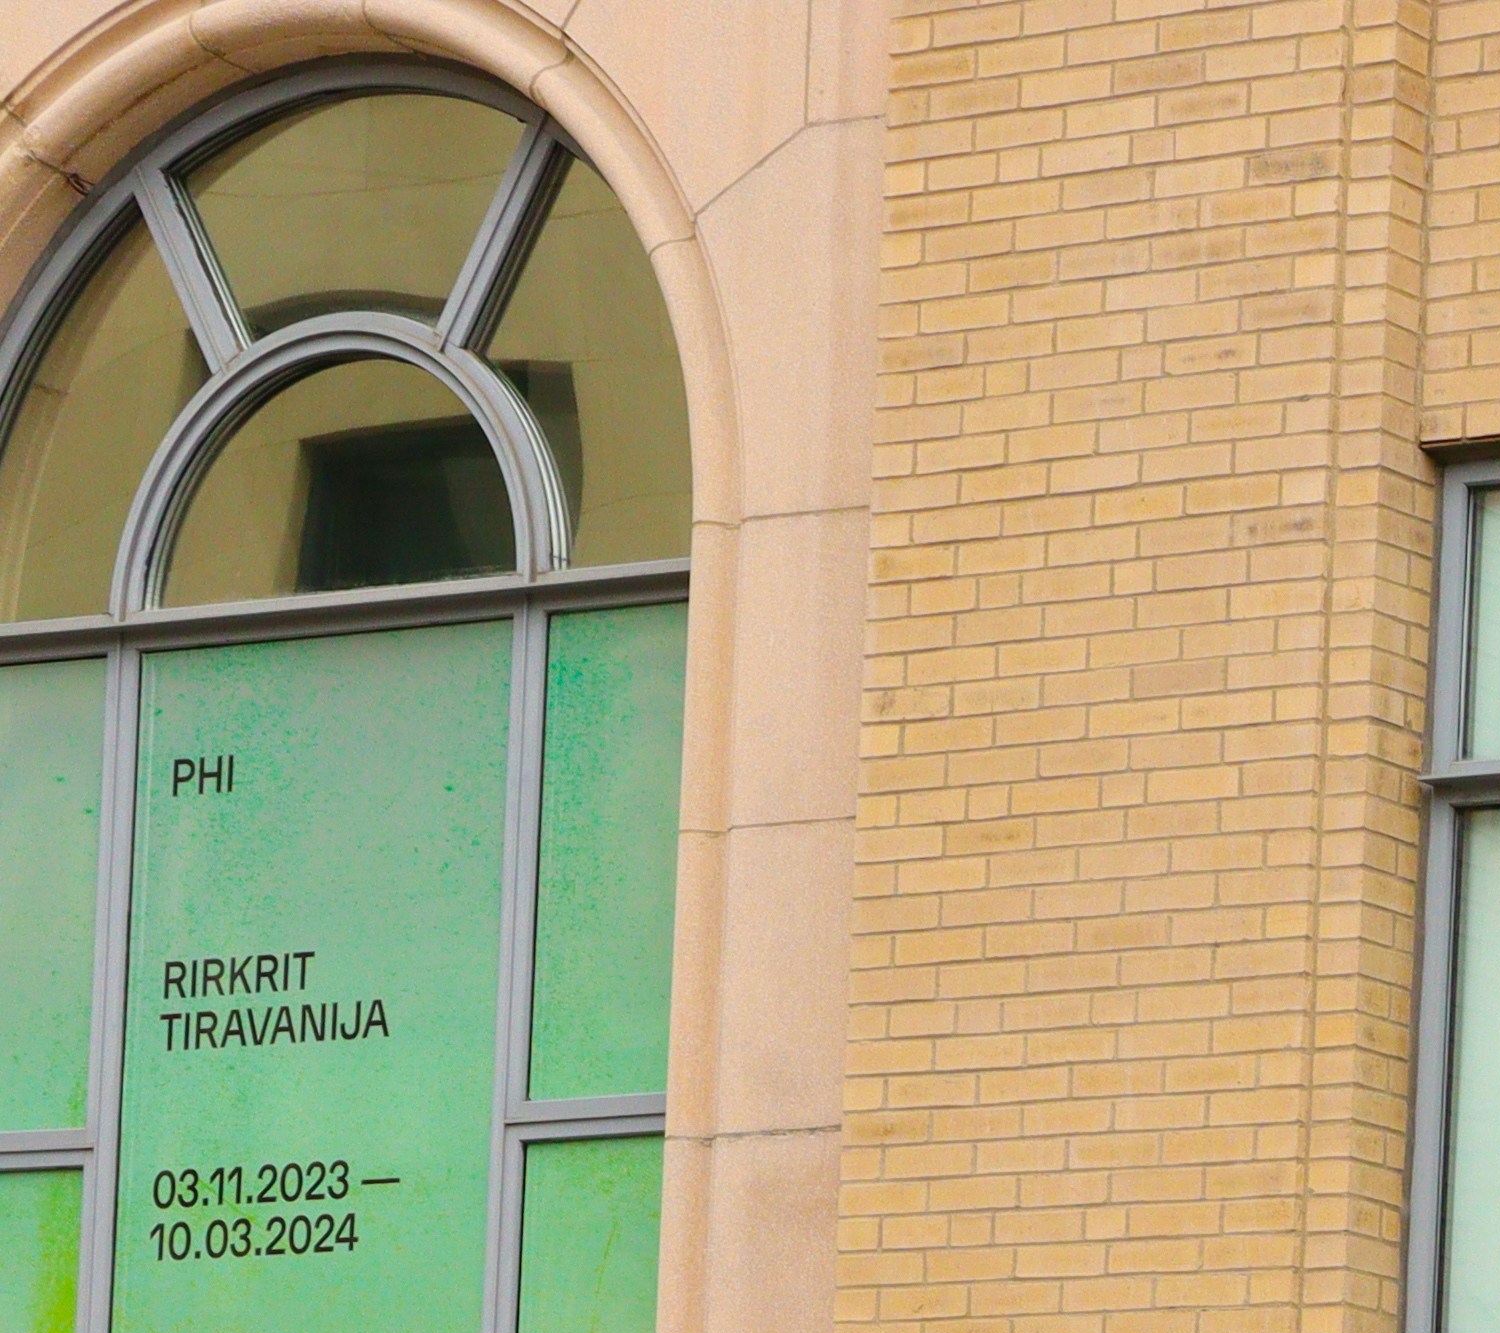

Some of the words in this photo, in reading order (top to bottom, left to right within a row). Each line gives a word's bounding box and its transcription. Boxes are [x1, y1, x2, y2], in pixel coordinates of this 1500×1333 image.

[172, 754, 234, 797] PHI
[164, 951, 315, 999] RIRKRIT
[161, 1000, 389, 1051] TIRAVANIJA
[153, 1161, 350, 1209] 03.11.2023
[150, 1213, 359, 1261] 10.03.2024
